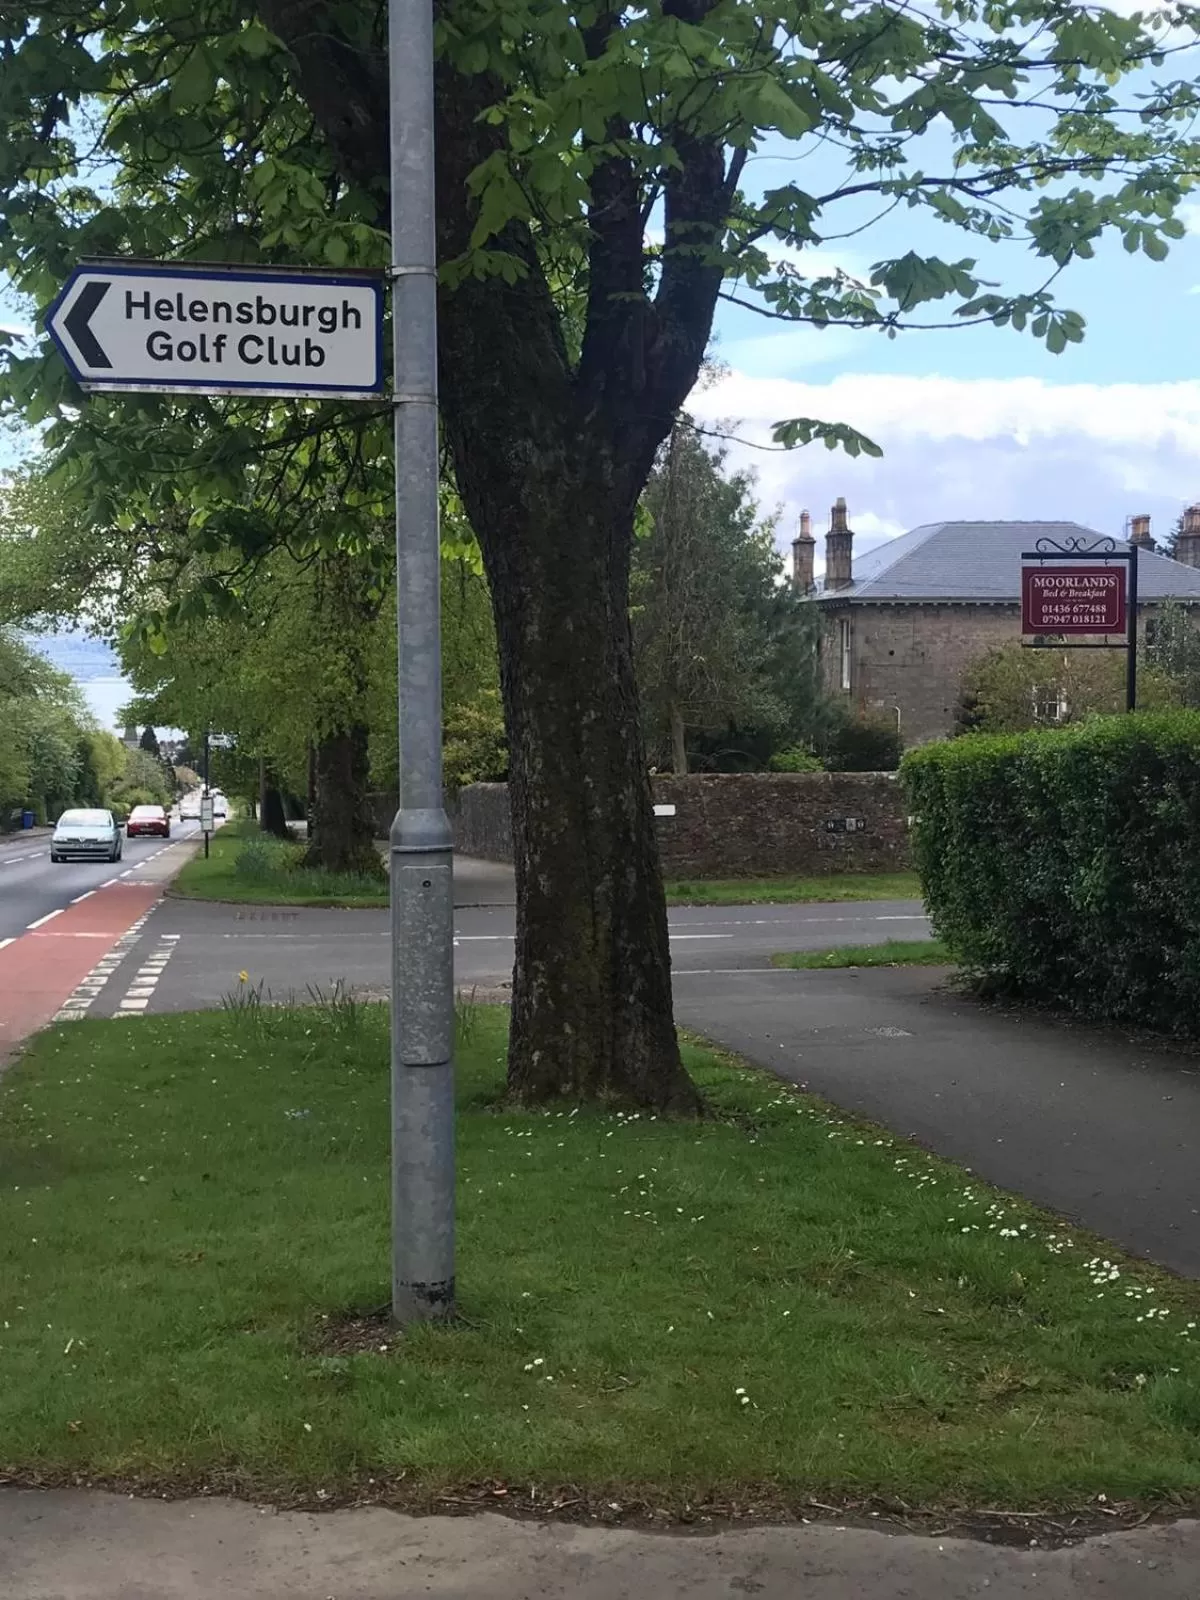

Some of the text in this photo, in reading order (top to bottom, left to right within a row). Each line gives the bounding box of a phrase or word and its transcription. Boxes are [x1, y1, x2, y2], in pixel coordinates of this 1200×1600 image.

[125, 290, 362, 333] Helensburgh
[146, 330, 326, 367] Golf Club
[1034, 577, 1115, 588] MOORLANDS
[1042, 588, 1106, 599] Bed & Breakfast
[1041, 604, 1107, 613] 01436 677488
[1042, 614, 1106, 624] 07947 018121
